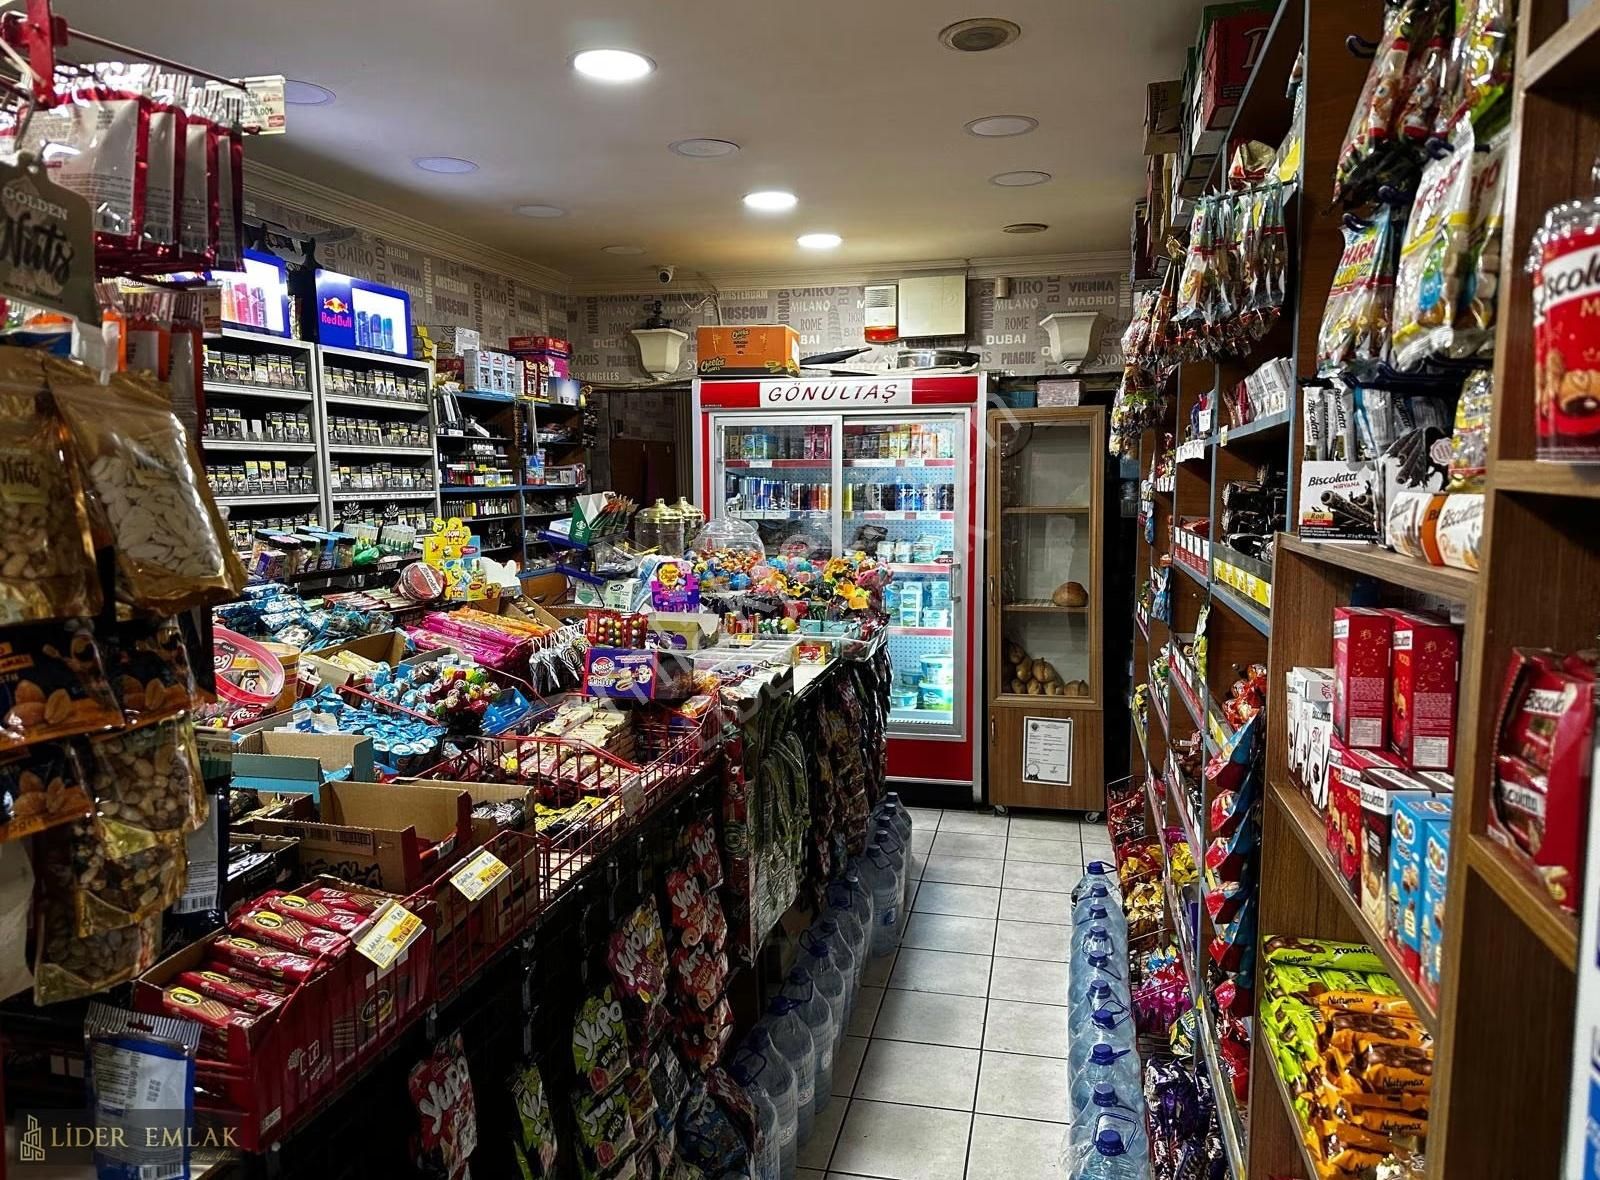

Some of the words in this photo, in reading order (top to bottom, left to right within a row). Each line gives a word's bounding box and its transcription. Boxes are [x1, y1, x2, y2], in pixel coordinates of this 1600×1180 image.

[3, 187, 68, 220] GOLDEN
[1069, 280, 1114, 293] VIENNA
[791, 300, 831, 313] MILANO
[1067, 295, 1117, 306] MADRID
[801, 317, 823, 331] ROME
[1004, 316, 1031, 331] ROME
[985, 335, 1027, 346] DUBAI
[768, 381, 898, 404] GÖNÜLTAŞ
[1308, 472, 1358, 487] Biscolata
[1383, 1078, 1425, 1091] Nutymax
[1380, 1120, 1422, 1133] Nutymax
